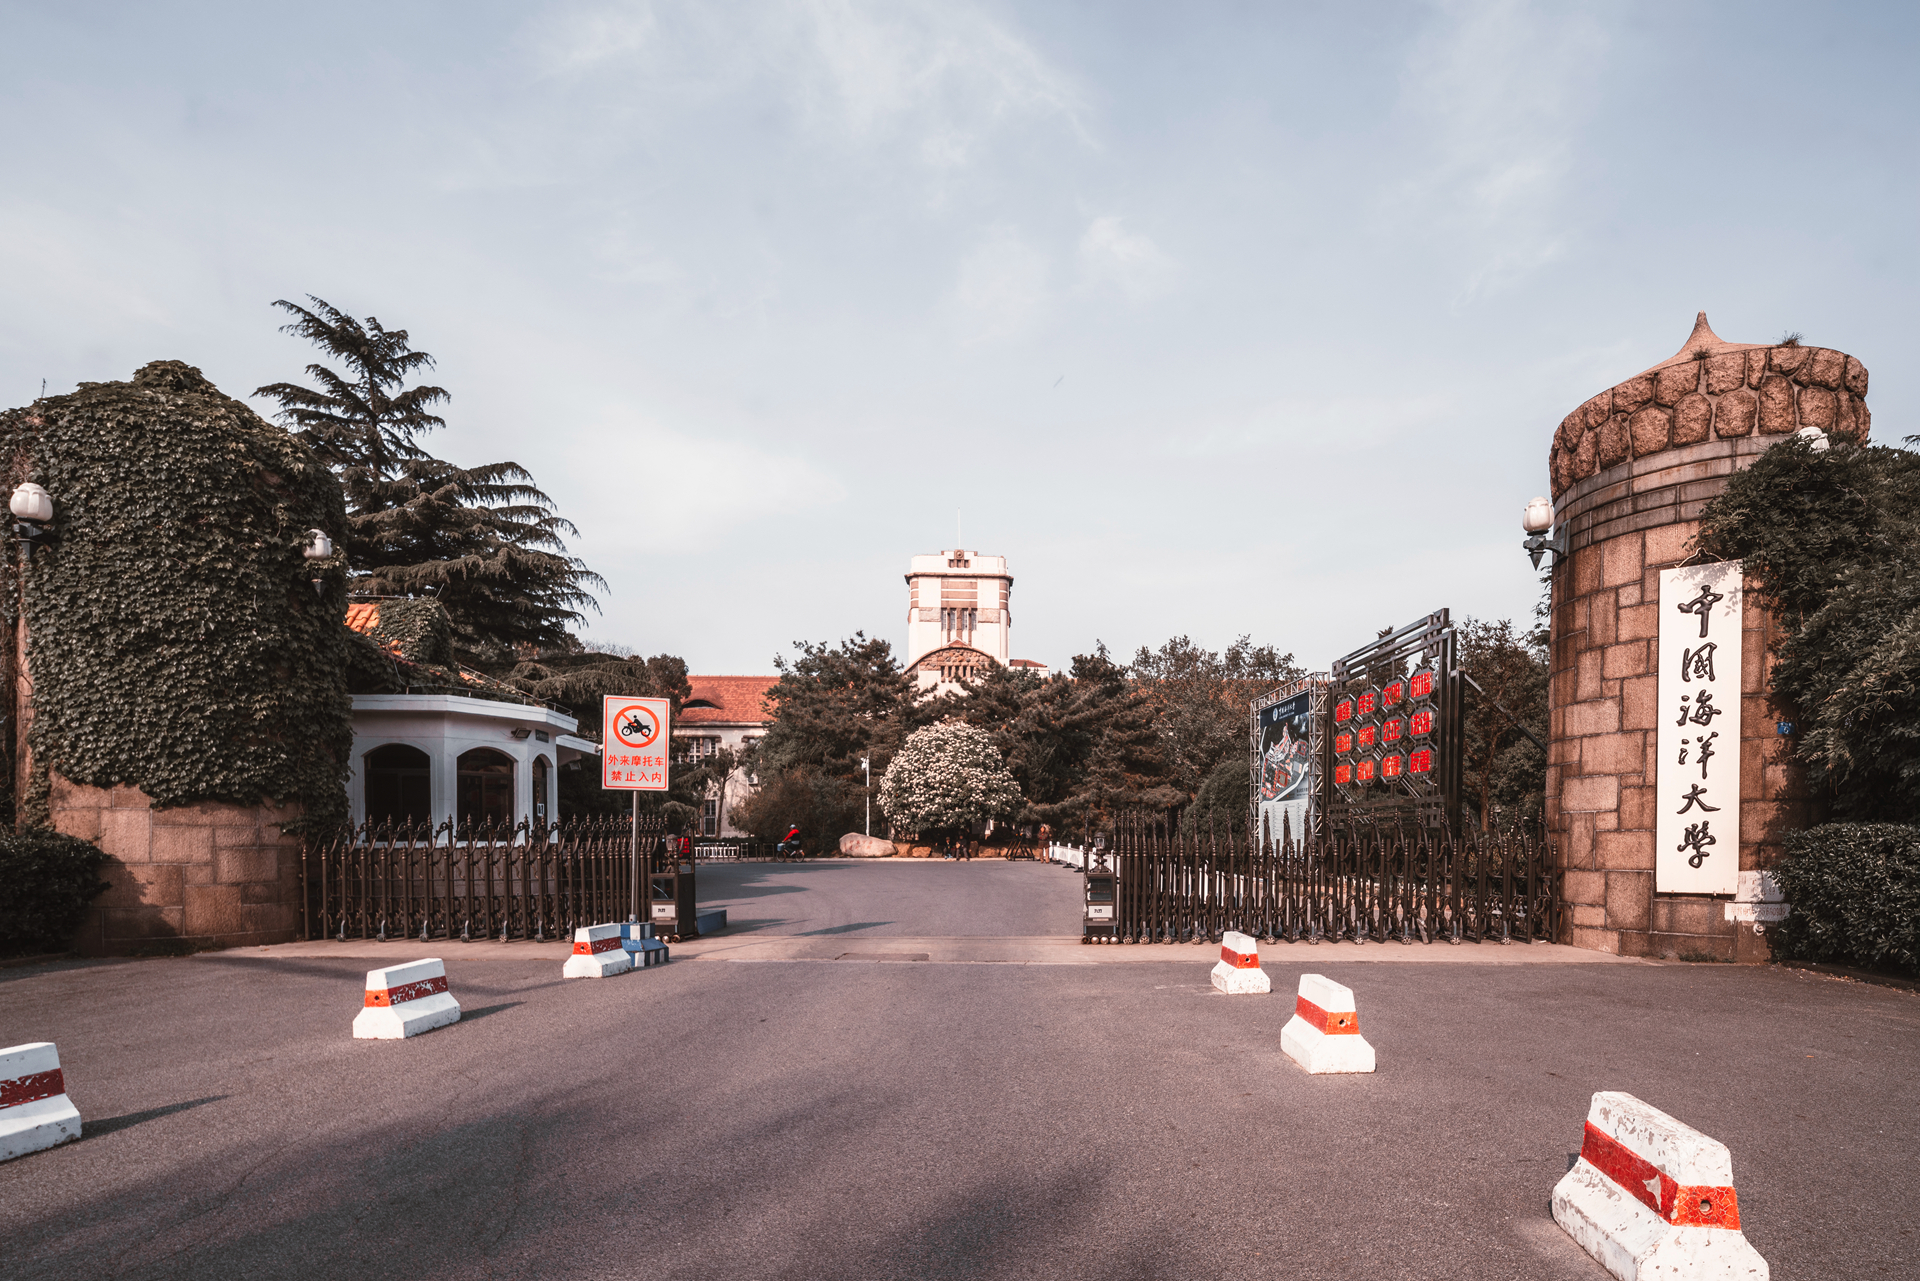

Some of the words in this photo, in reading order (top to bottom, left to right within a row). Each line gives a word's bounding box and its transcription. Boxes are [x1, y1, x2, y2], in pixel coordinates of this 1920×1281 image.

[1358, 693, 1375, 715] 民主
[1383, 683, 1402, 707] 文明
[1411, 672, 1432, 698] 和谐
[1336, 733, 1352, 753] 自由
[1358, 725, 1375, 747] 平等
[1383, 719, 1401, 742] 公正
[1411, 711, 1432, 736] 法治
[608, 754, 664, 767] 外来摩托车
[1410, 749, 1431, 773] 友善
[611, 770, 662, 783] 禁止入内
